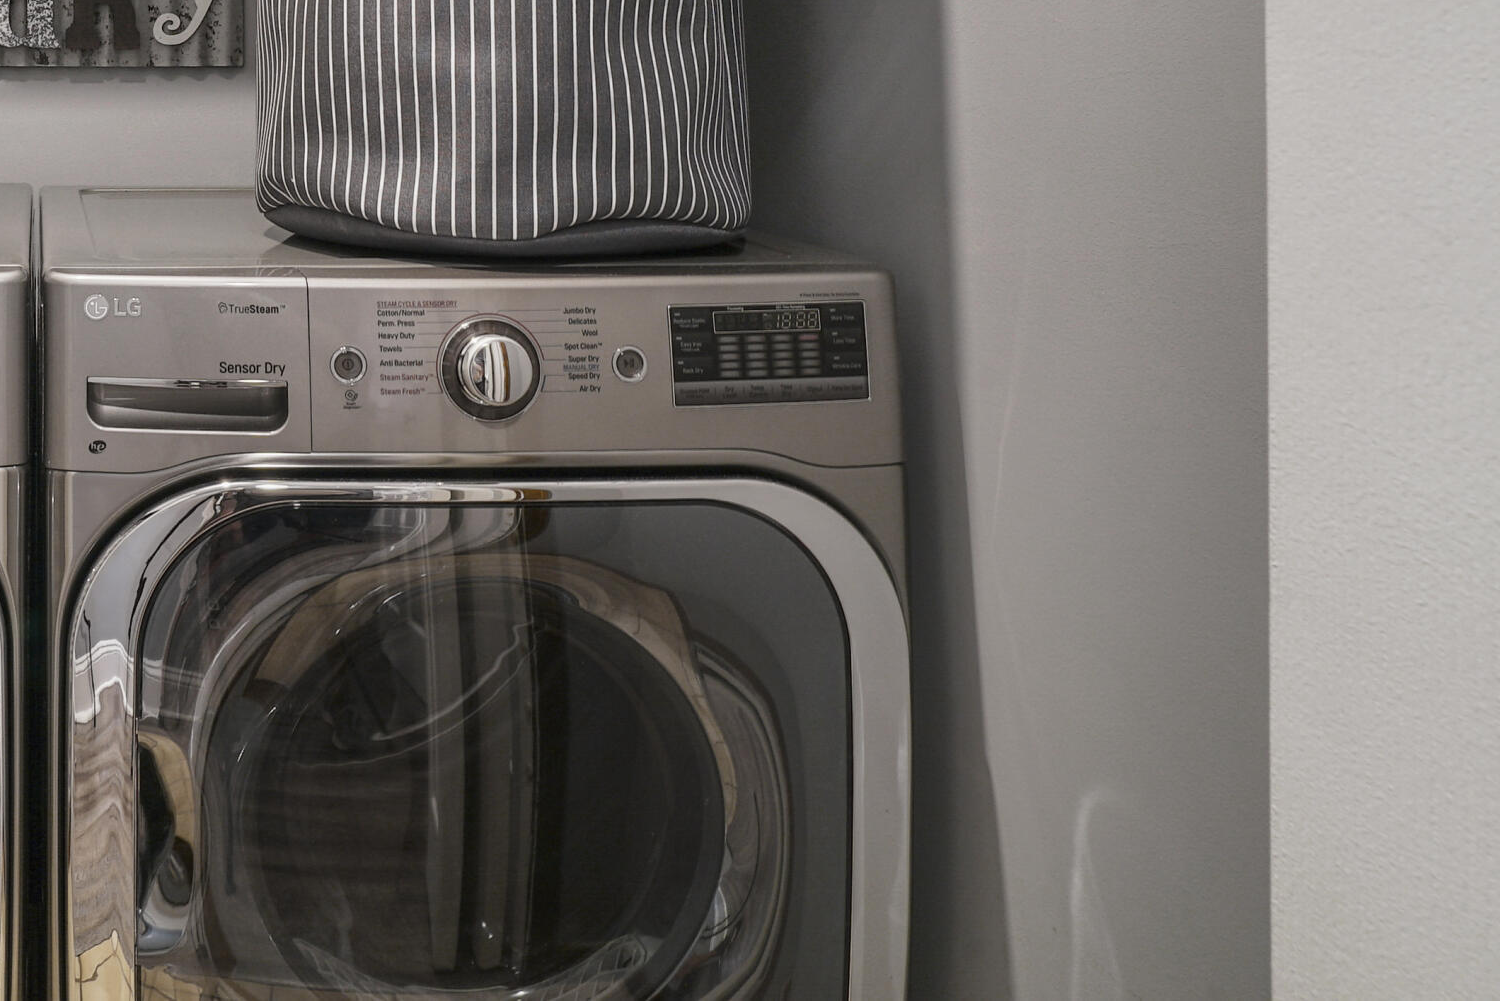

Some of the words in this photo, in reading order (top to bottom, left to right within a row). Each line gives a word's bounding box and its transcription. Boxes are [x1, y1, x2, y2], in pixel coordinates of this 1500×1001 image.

[114, 298, 142, 316] LG
[219, 362, 261, 374] Sensor
[264, 362, 286, 376] Dry
[590, 385, 601, 393] Dry
